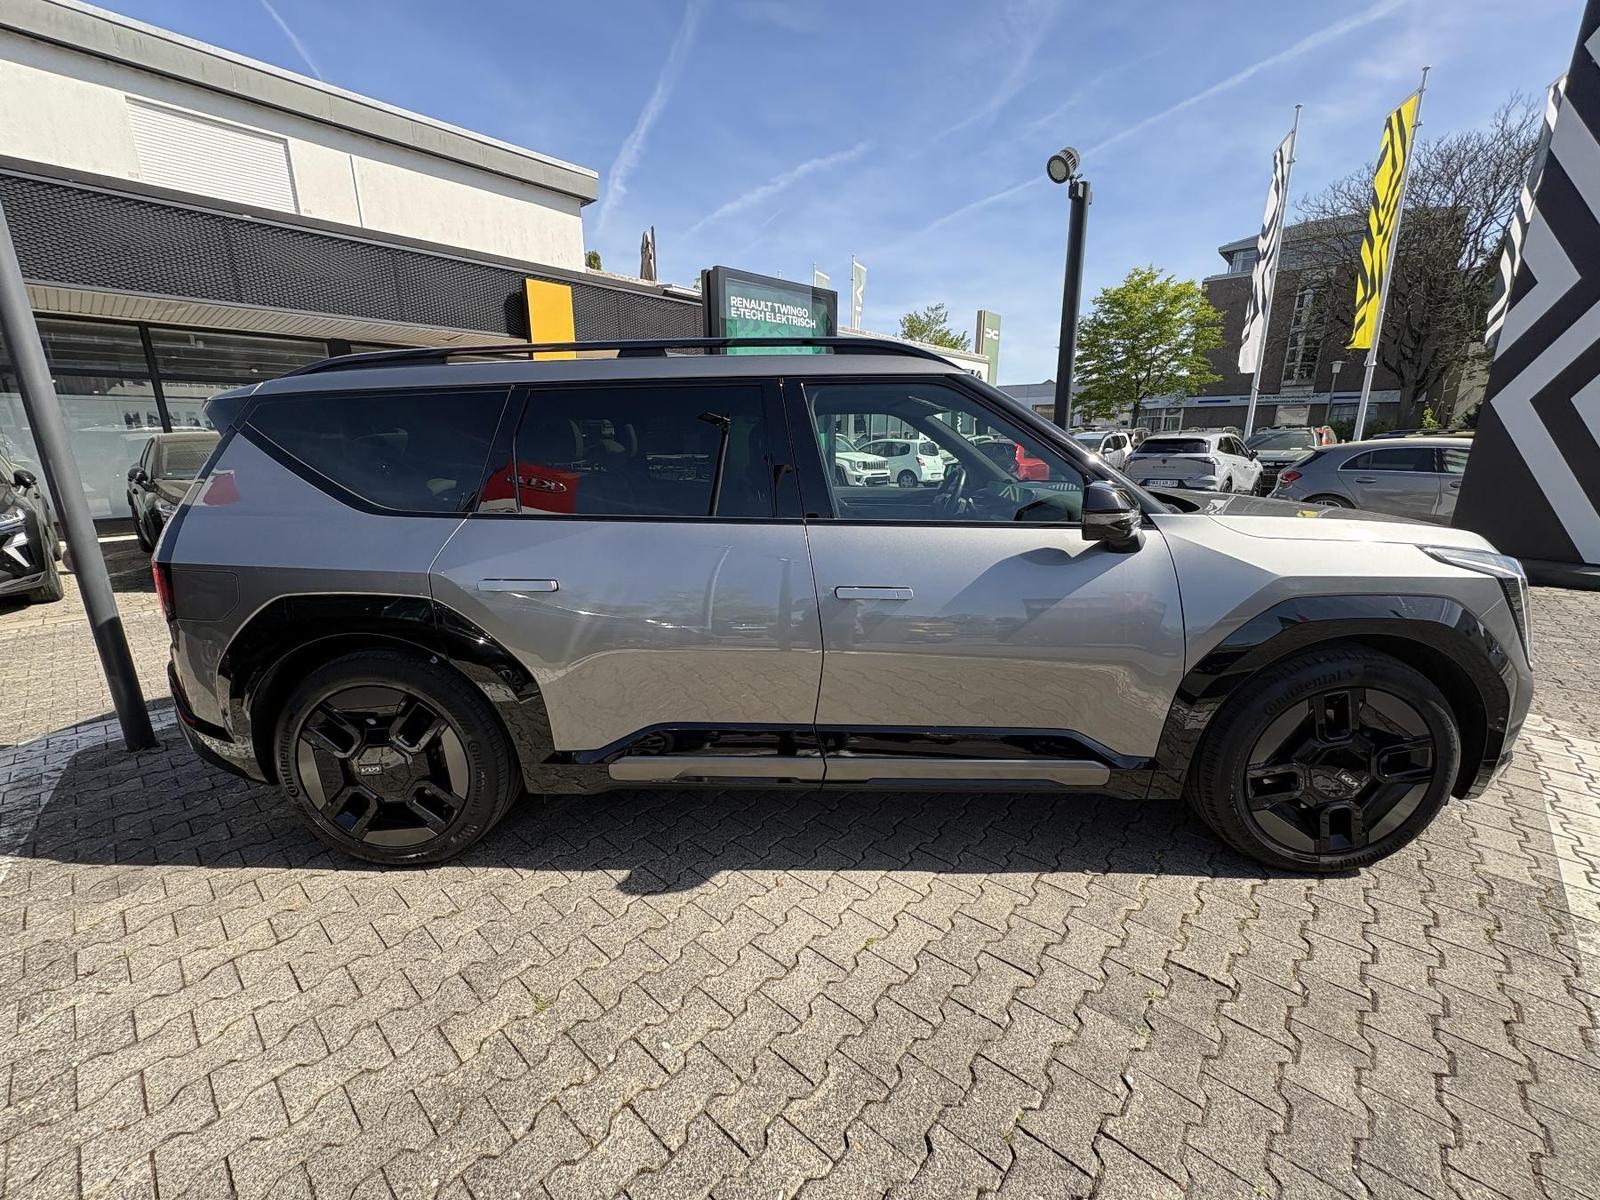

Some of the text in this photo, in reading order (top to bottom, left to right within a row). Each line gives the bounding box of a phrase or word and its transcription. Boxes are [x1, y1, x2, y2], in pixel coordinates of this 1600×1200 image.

[730, 296, 809, 317] RENAULT TWINGO
[730, 308, 816, 329] E-TECH ELEKTRISCH
